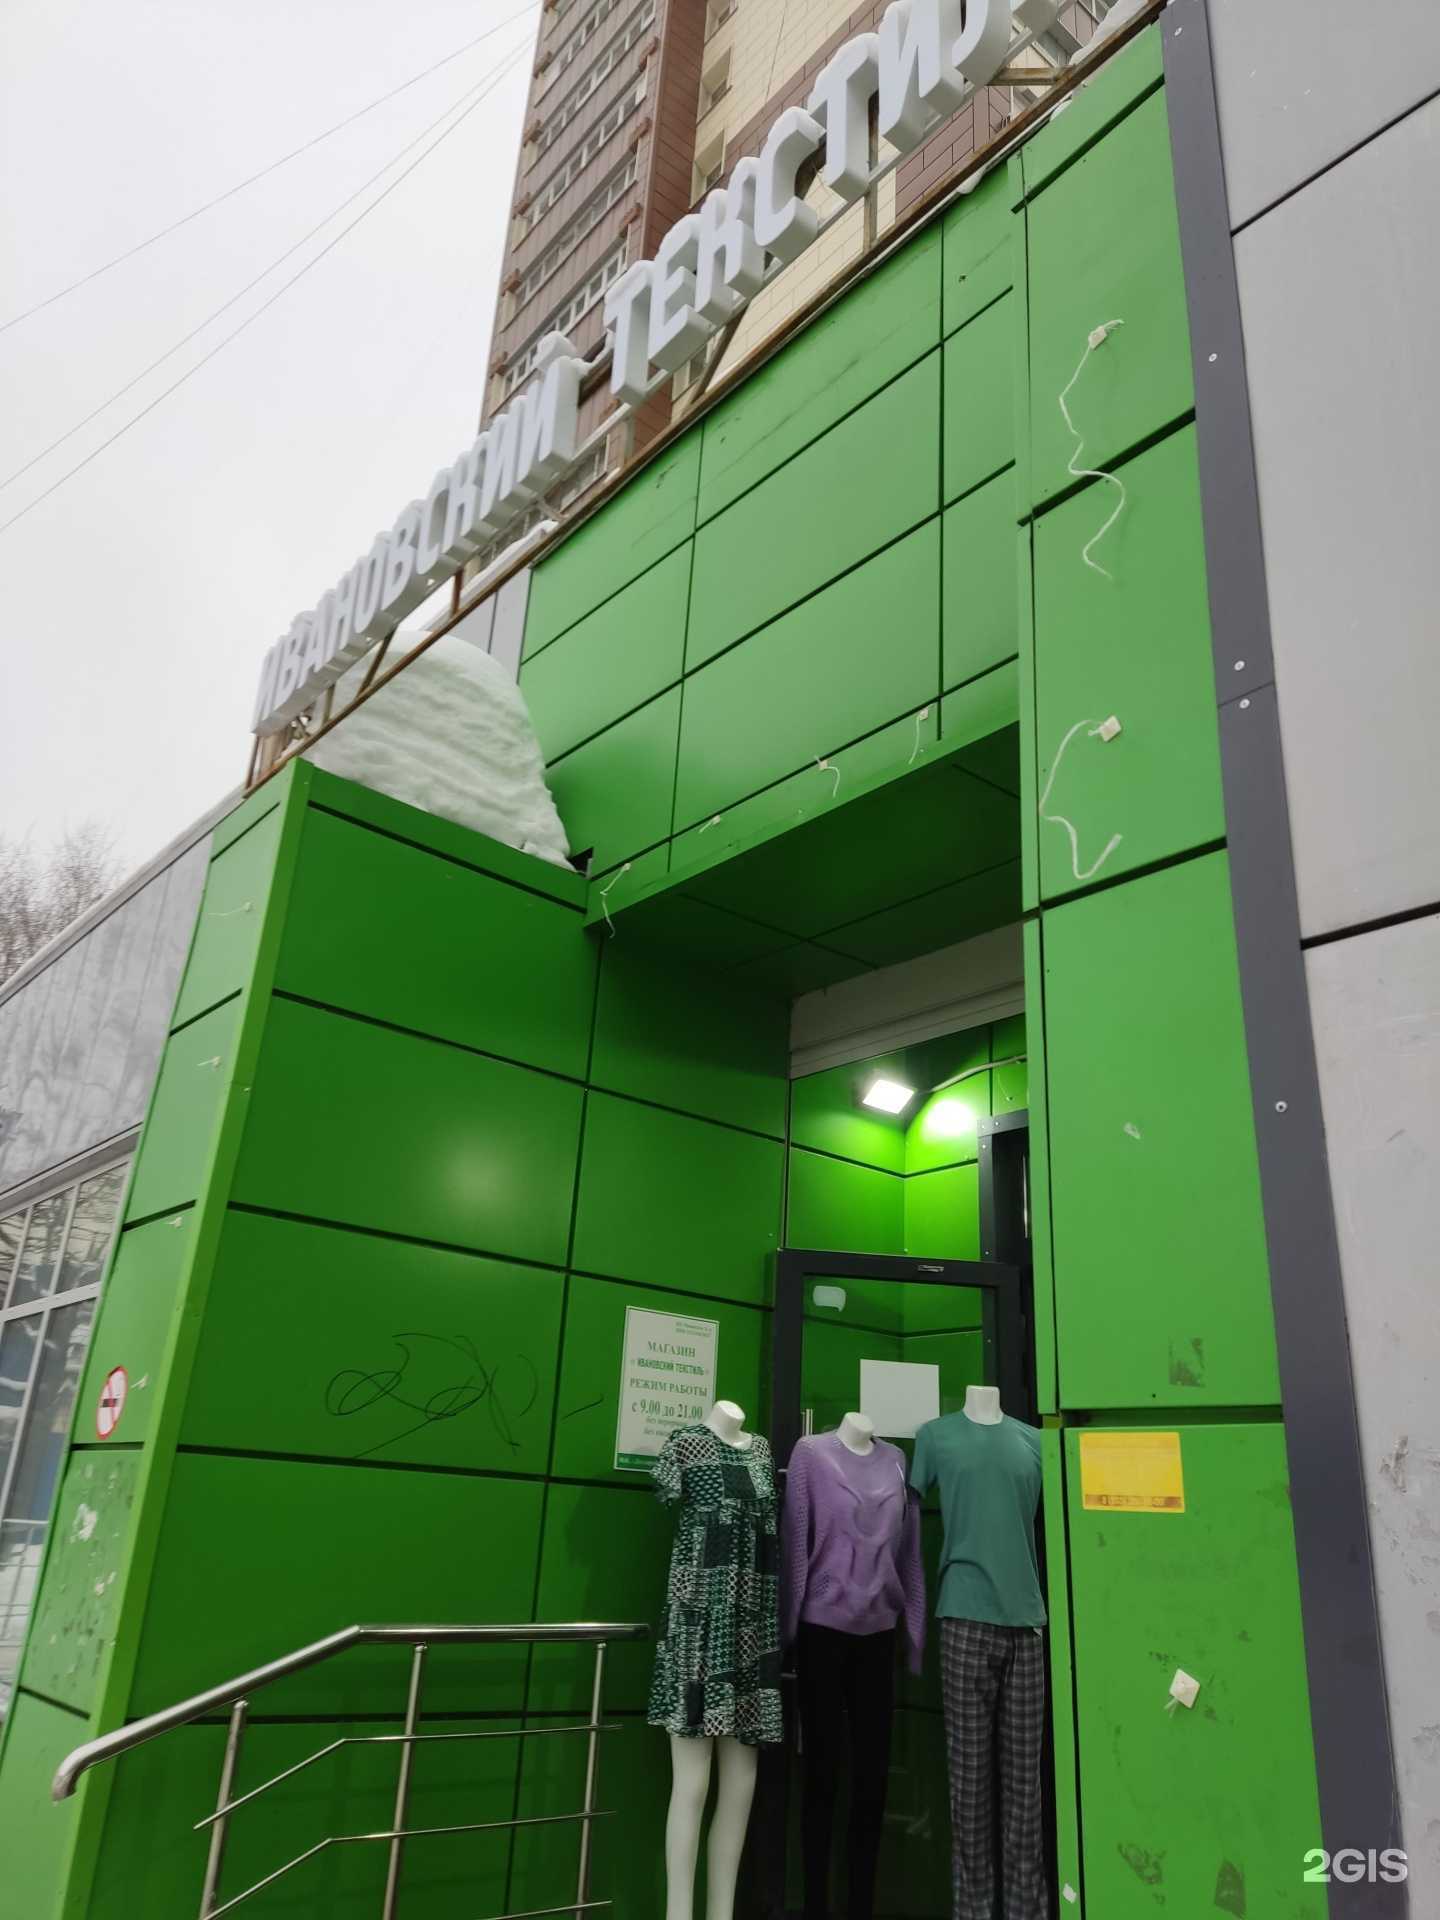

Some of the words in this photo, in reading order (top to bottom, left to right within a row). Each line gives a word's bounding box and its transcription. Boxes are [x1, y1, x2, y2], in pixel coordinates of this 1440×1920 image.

[647, 1340, 696, 1358] МАГАЗИН
[629, 1377, 668, 1392] РЕЖИМ
[669, 1383, 708, 1397] РАБОТЫ
[640, 1399, 661, 1415] 9.00
[662, 1405, 675, 1417] до
[677, 1403, 703, 1420] 21.00
